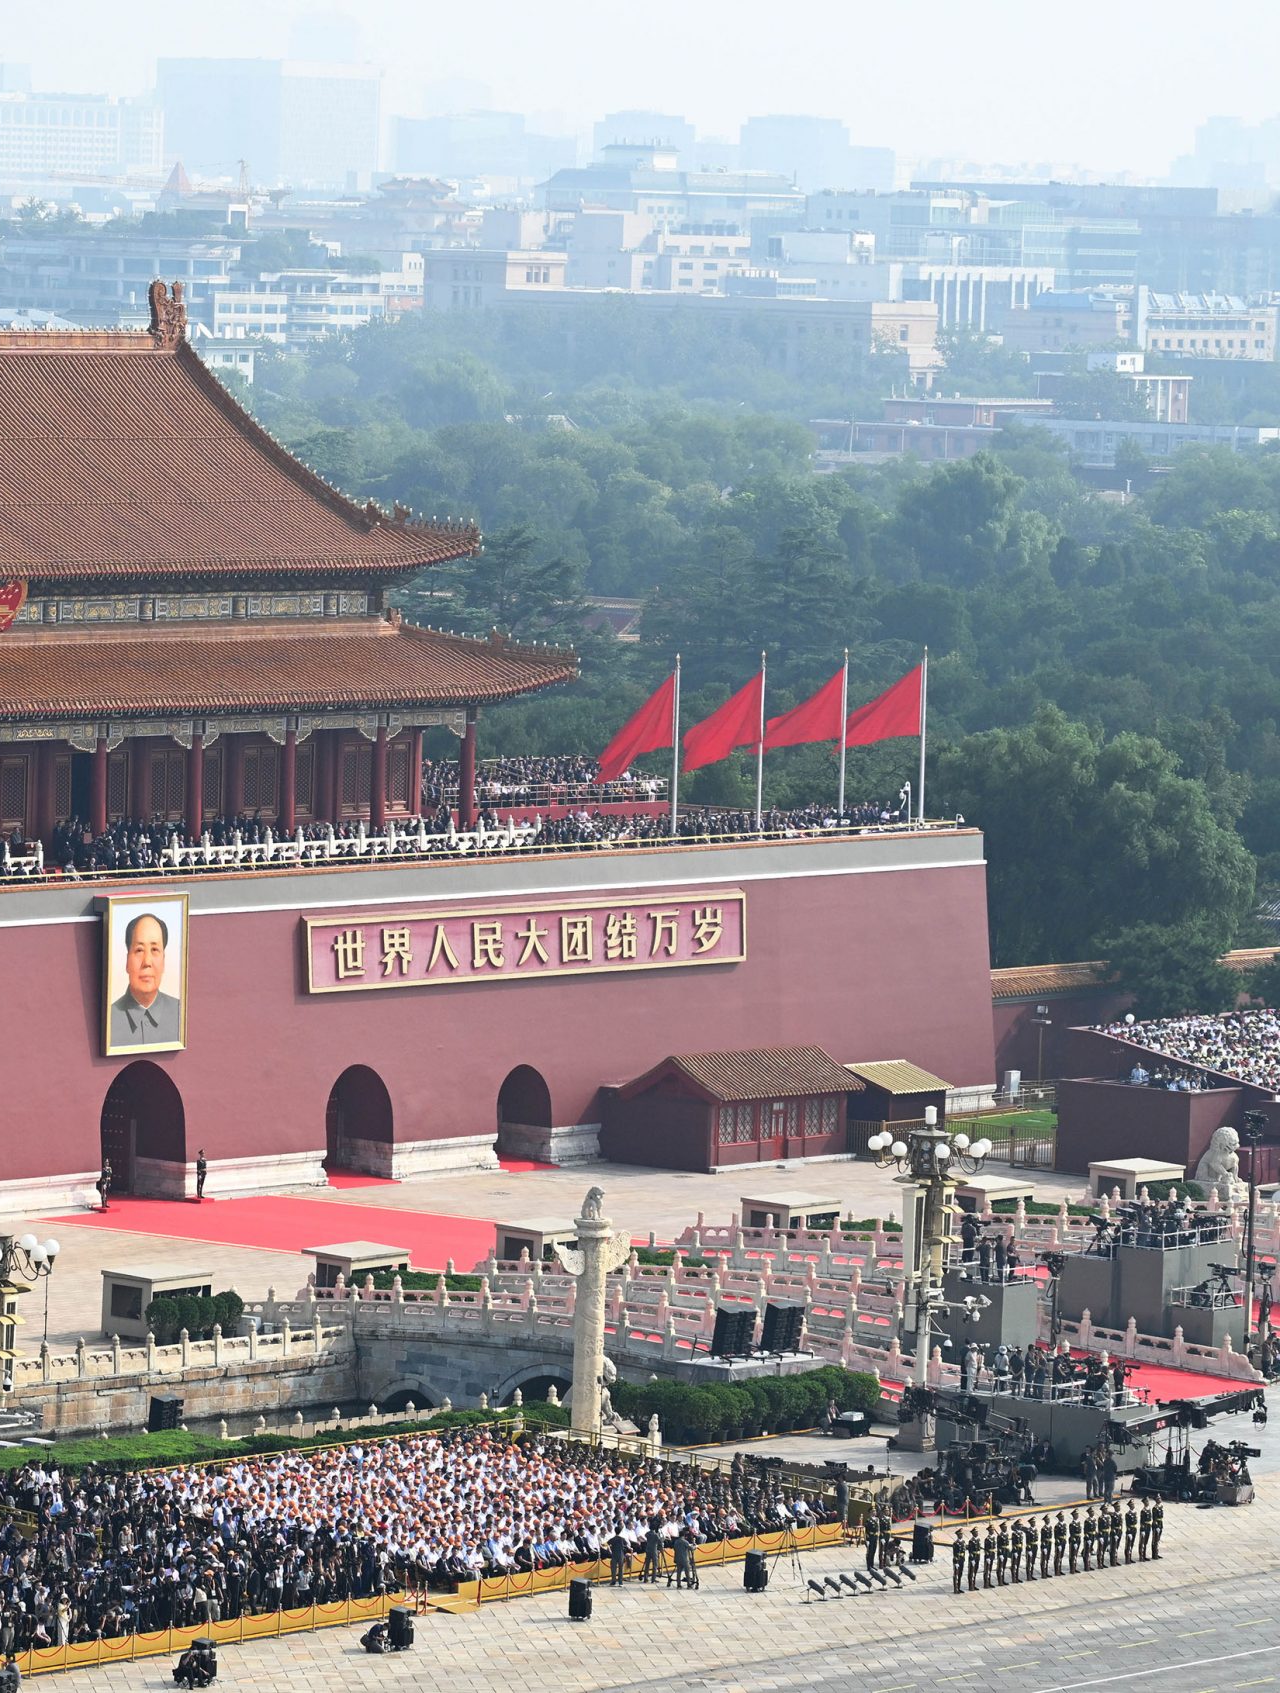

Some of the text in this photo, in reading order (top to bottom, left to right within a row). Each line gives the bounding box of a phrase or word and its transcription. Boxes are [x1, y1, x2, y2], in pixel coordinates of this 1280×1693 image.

[333, 907, 724, 979] 世界人民大团结万岁
